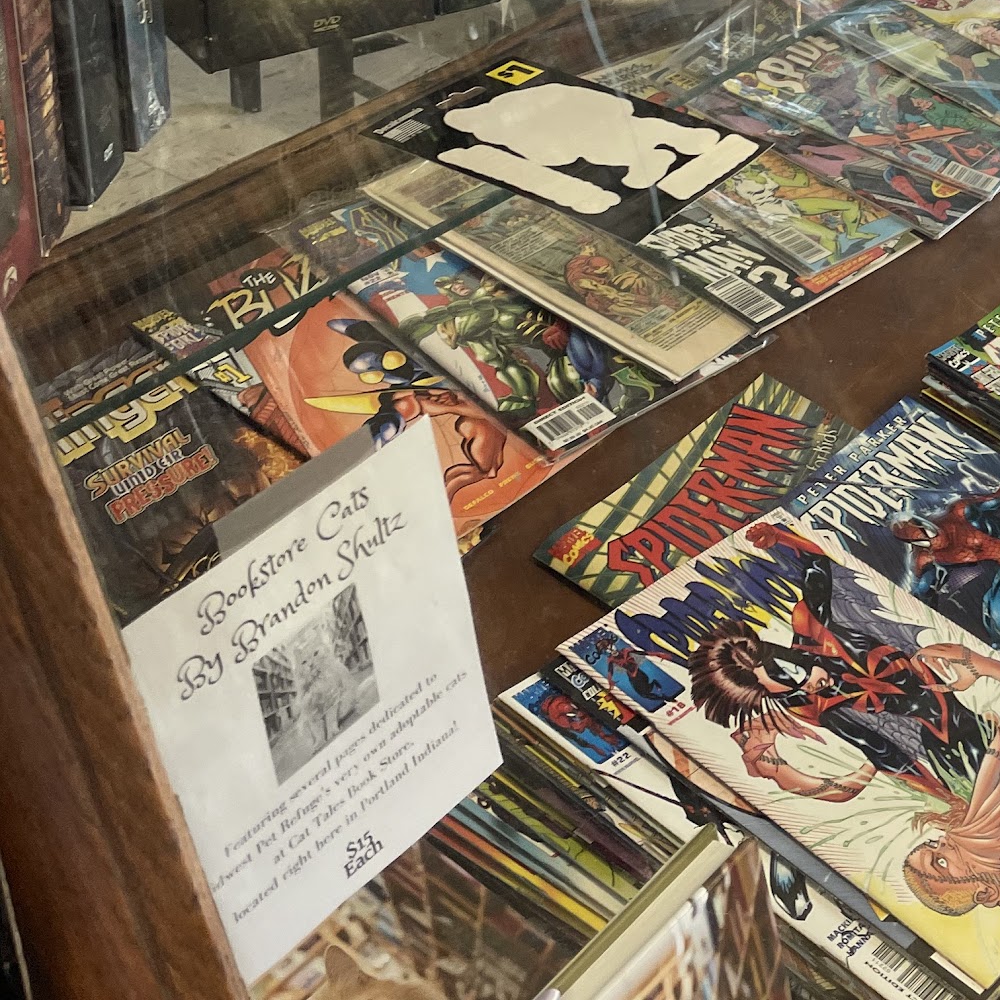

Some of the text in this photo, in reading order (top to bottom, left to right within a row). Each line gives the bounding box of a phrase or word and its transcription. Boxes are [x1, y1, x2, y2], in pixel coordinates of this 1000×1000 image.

[755, 34, 842, 95] SPIDE
[242, 271, 277, 289] THE
[213, 362, 252, 384] #1
[83, 427, 192, 501] SURVIVAL
[104, 443, 220, 525] PRESSURE!
[110, 448, 185, 497] UNDER
[797, 414, 908, 505] PETER PARKER
[798, 415, 975, 556] SPIDER-MAN
[463, 489, 495, 512] DEFALCO
[606, 403, 810, 588] SPIDER-MAN
[197, 486, 370, 637] Bookstore Cats
[562, 532, 595, 565] COMICS
[176, 511, 408, 702] By Brandon Shultz
[664, 701, 687, 718] #18
[223, 672, 438, 859] Featuring several pages dedicated to
[255, 834, 278, 855] Pet
[279, 786, 332, 835] Refuge's
[333, 763, 360, 788] very
[362, 740, 388, 764] own
[389, 690, 444, 742] adoptable
[444, 670, 468, 693] cats
[610, 751, 632, 768] #22
[232, 719, 461, 925] located right here in Portland Indiana!
[272, 740, 415, 867] at Cat Tales Book Store.
[342, 840, 385, 880] Each
[346, 831, 375, 859] $15
[863, 960, 906, 998] EDITION
